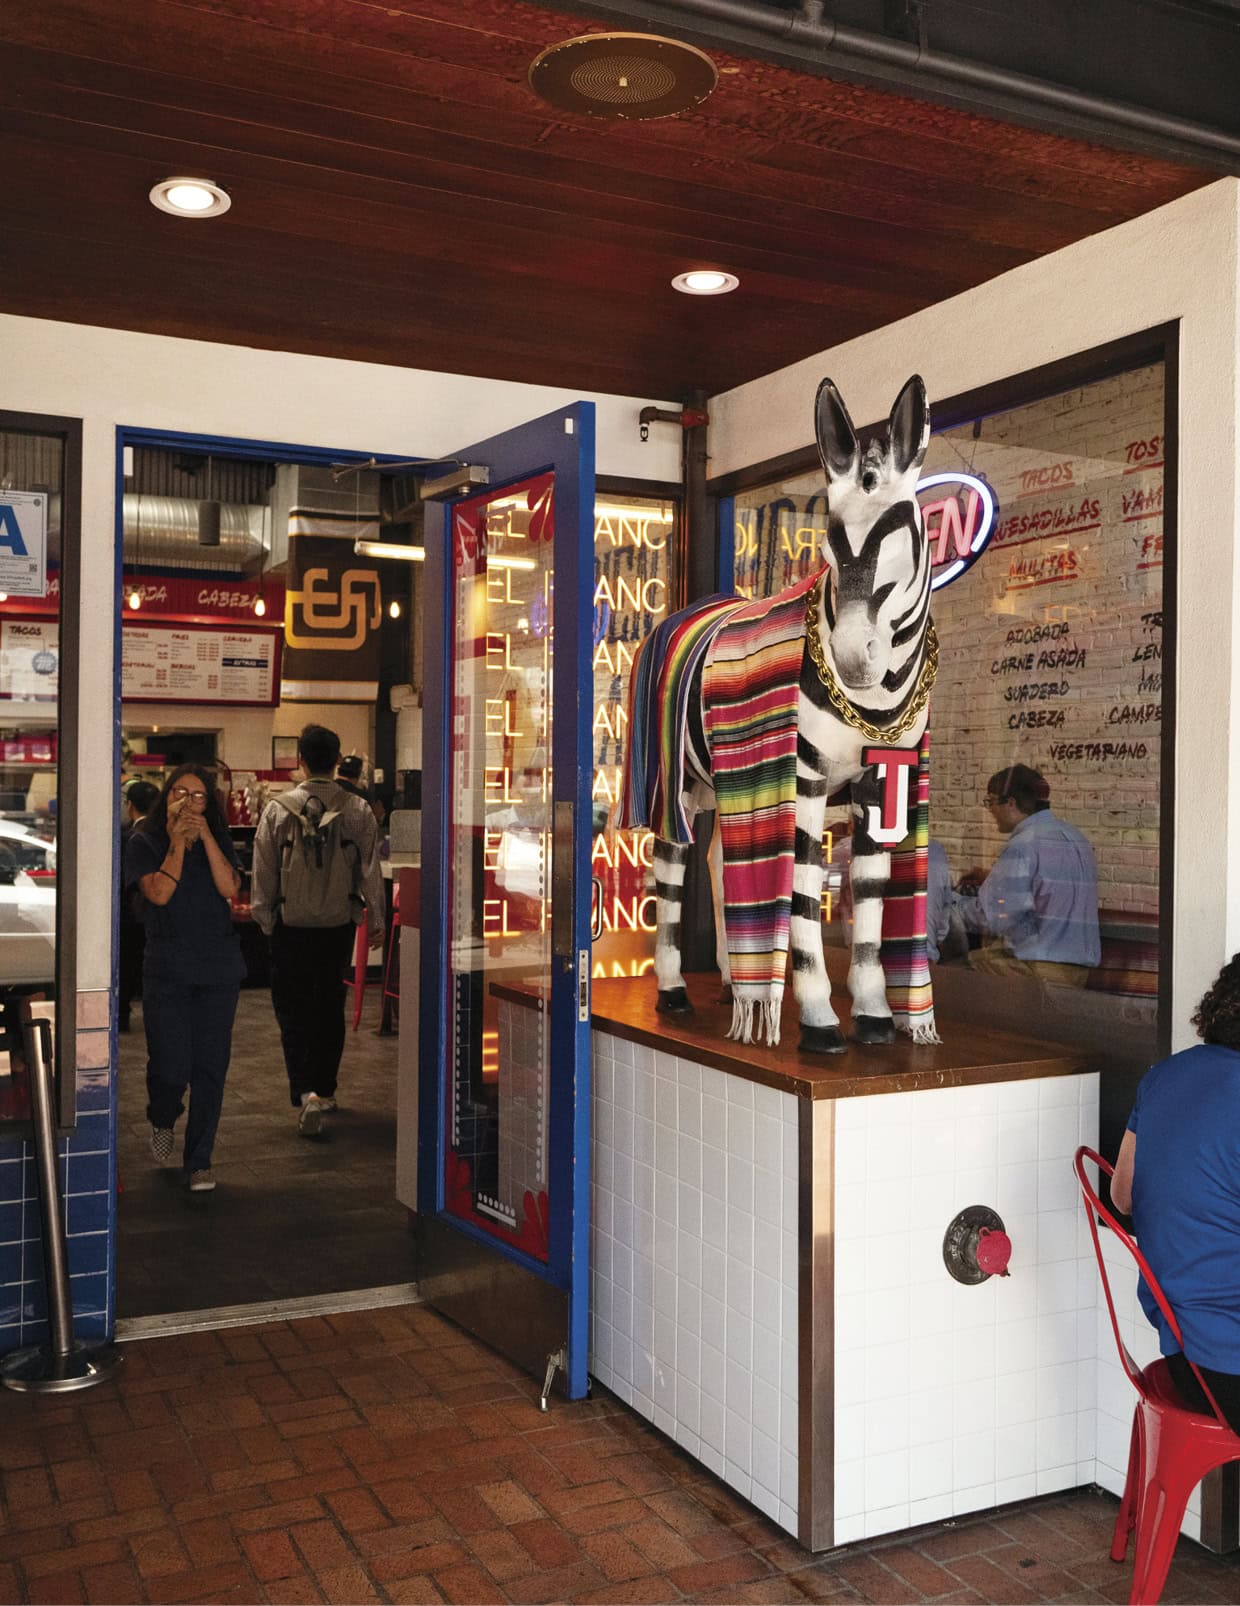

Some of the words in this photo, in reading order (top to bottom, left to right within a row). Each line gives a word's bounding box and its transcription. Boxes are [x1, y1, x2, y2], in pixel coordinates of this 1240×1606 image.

[1125, 435, 1164, 464] TOS
[1021, 461, 1073, 490] TACOS
[0, 504, 28, 556] A
[921, 489, 979, 566] EN
[993, 498, 1100, 543] UESADILLAS
[486, 566, 525, 605] EL
[486, 631, 523, 670] EL
[1006, 622, 1069, 646] ADOBADA
[991, 653, 1034, 675] CARNE
[1037, 647, 1087, 670] ASADA
[1004, 680, 1071, 702] SUADERO
[485, 699, 524, 737] EL
[1008, 711, 1066, 730] CABEZA
[1049, 742, 1147, 762] VEGETARIANO
[484, 765, 523, 804] EL
[483, 899, 521, 938] EL
